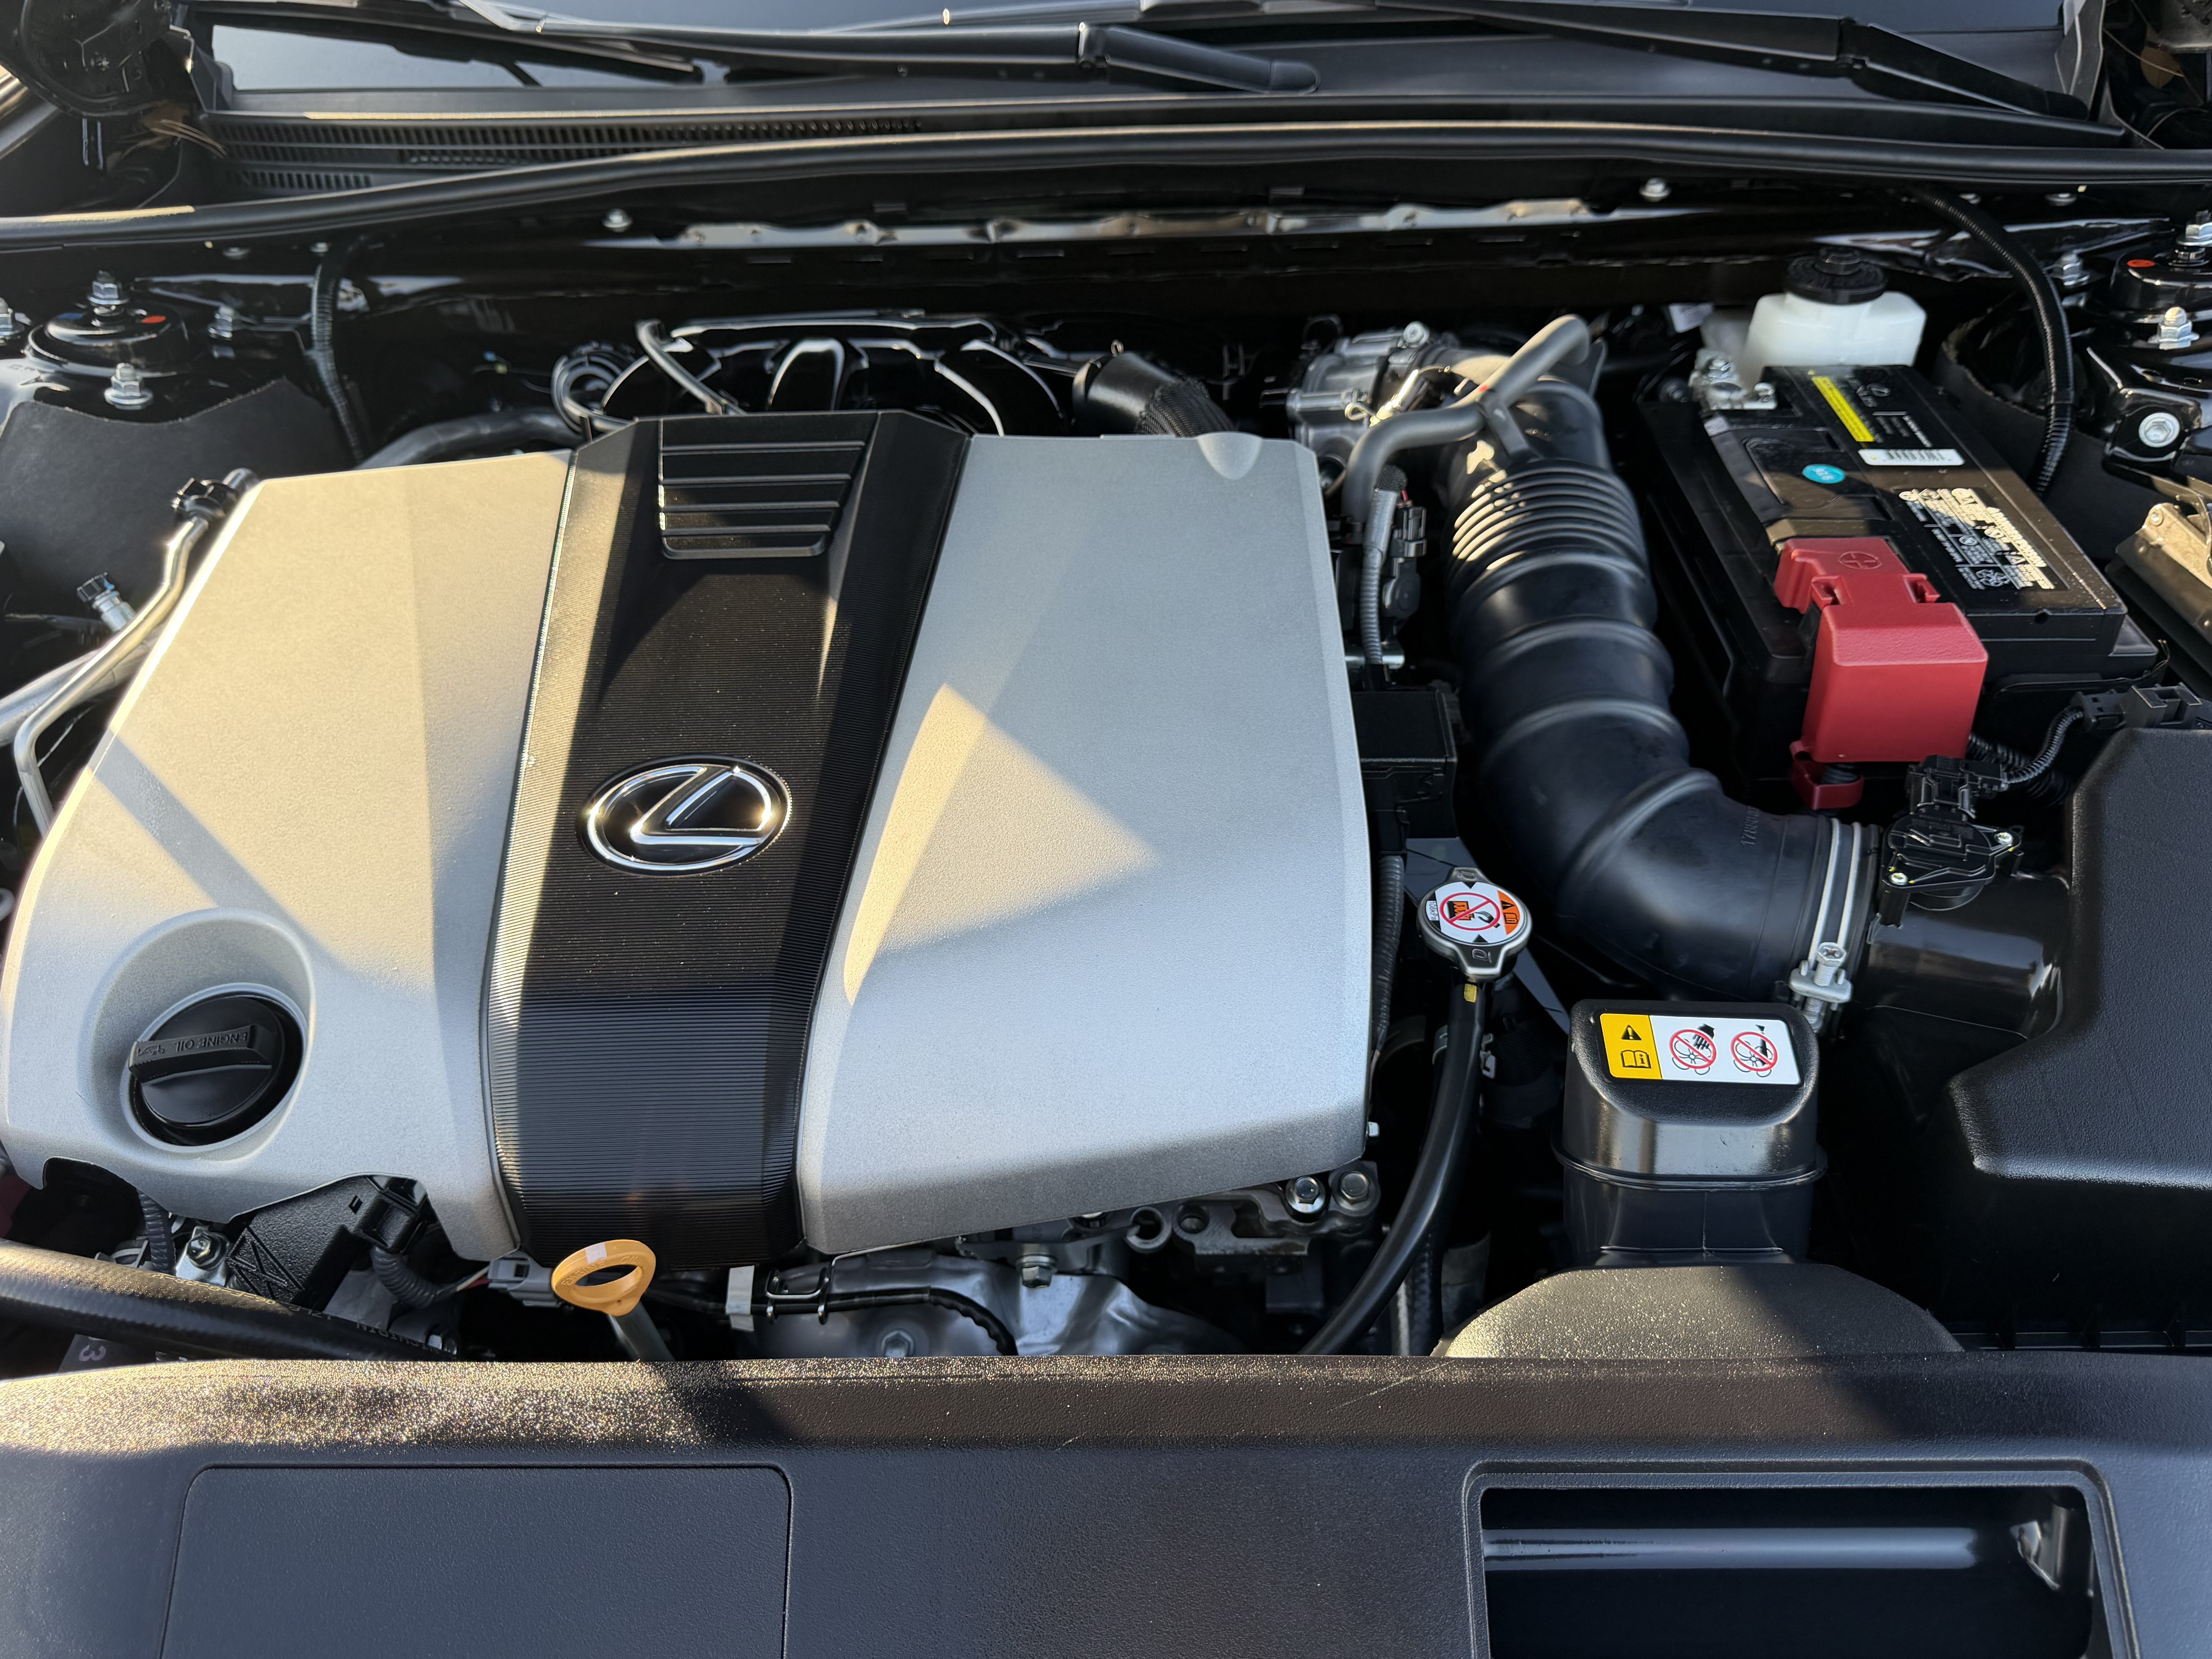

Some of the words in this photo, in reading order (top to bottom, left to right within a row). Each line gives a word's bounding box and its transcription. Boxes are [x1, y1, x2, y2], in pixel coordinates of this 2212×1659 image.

[175, 1039, 194, 1053] OIL
[197, 1032, 248, 1048] ENGINE
[561, 1261, 605, 1285] ENGINE
